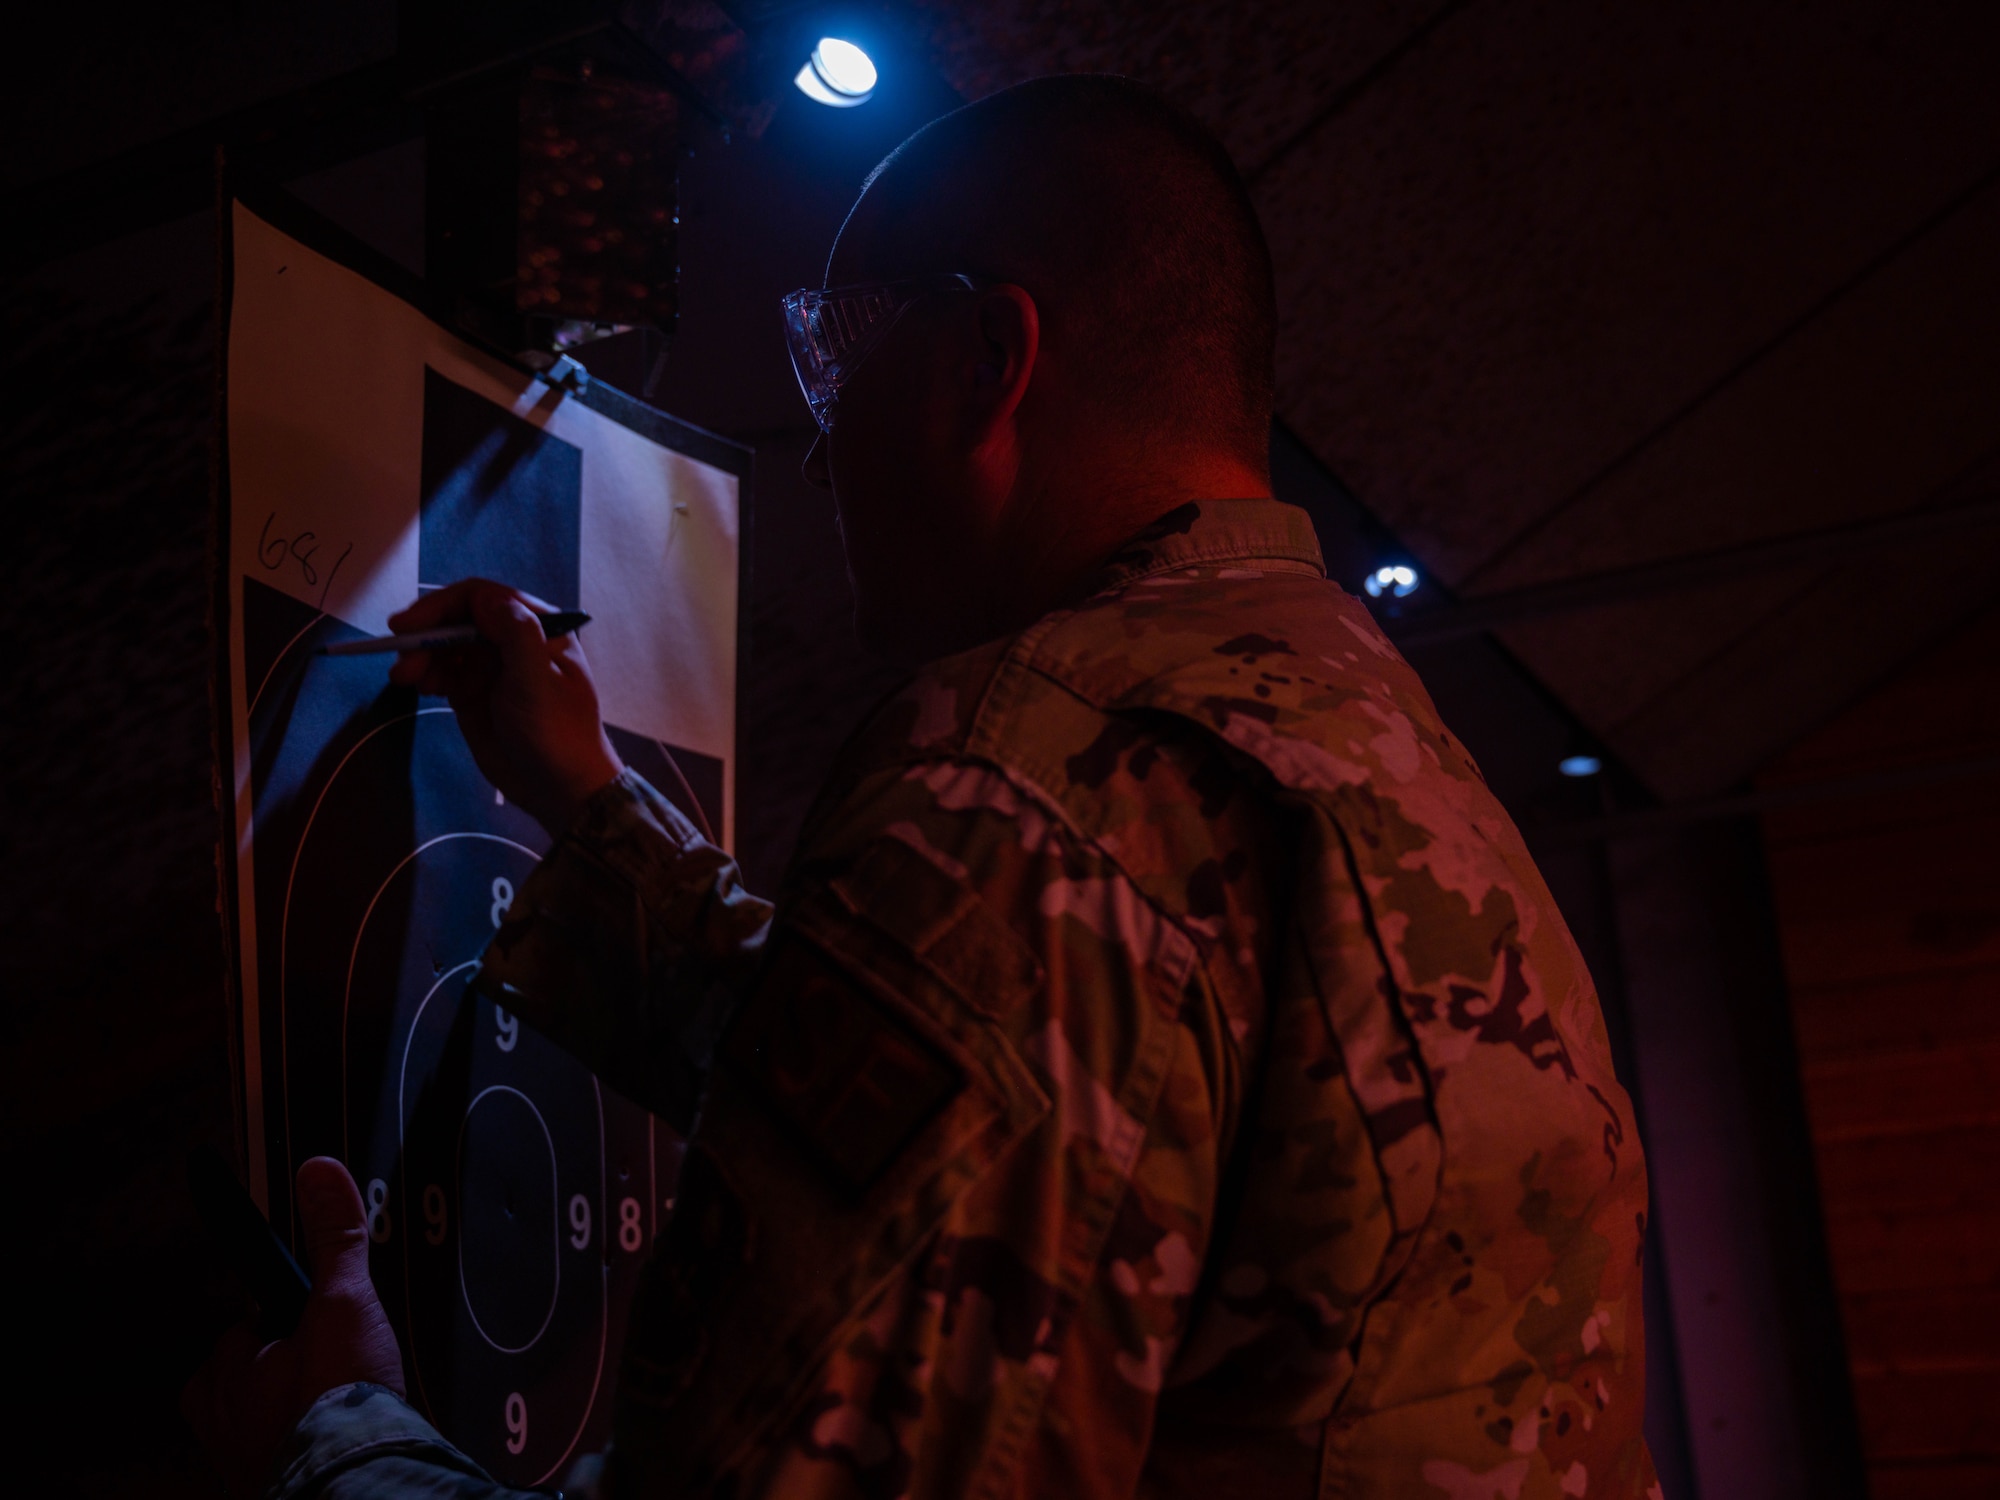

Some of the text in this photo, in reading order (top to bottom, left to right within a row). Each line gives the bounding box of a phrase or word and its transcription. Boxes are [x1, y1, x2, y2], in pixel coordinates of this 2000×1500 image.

[367, 1178, 641, 1252] 8 9 9 8
[505, 1392, 528, 1455] 9
